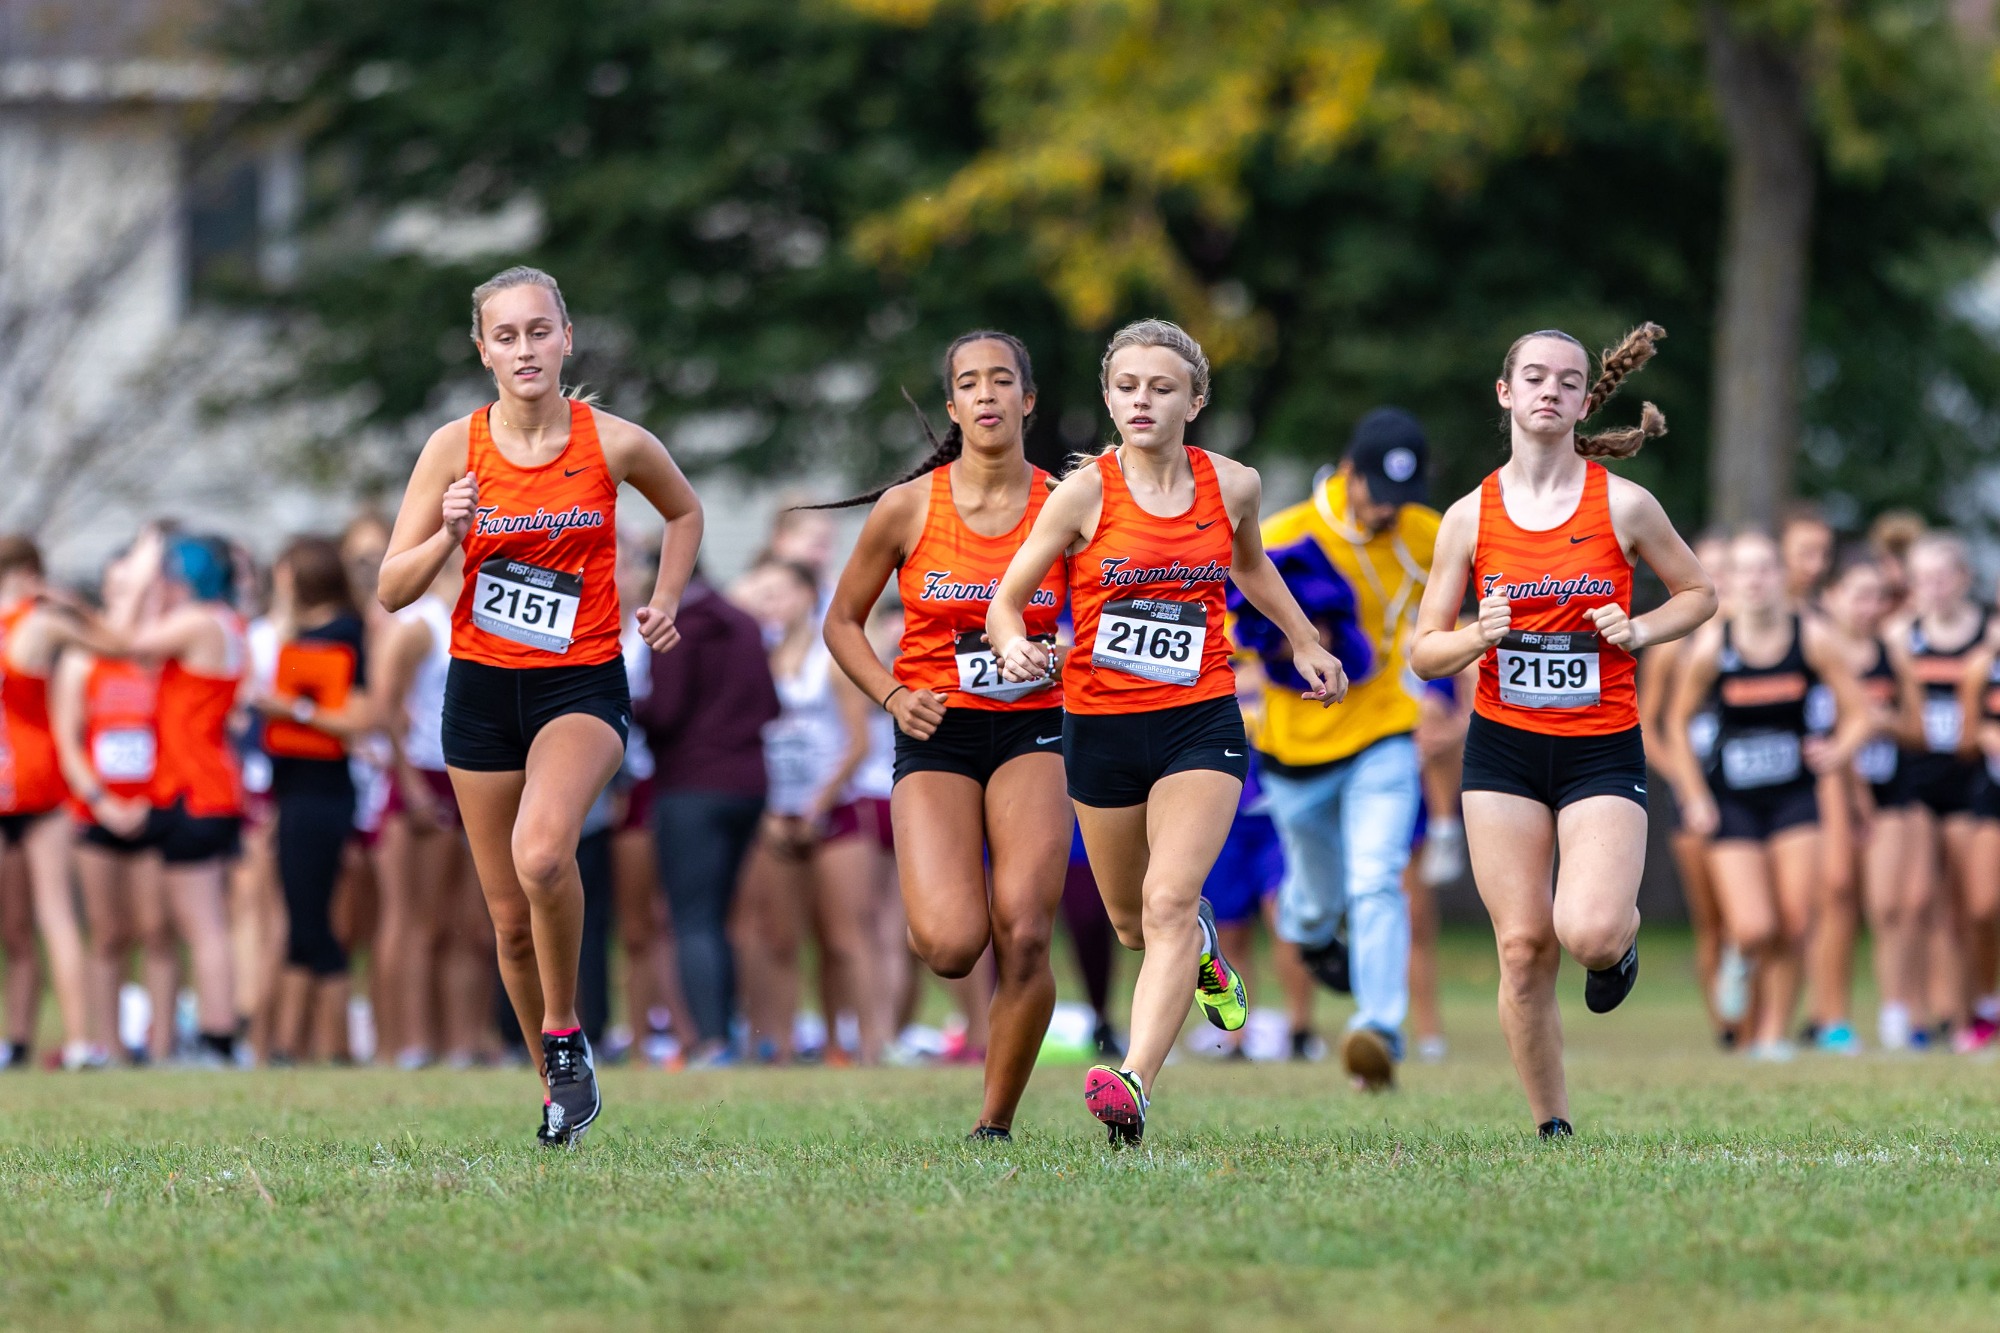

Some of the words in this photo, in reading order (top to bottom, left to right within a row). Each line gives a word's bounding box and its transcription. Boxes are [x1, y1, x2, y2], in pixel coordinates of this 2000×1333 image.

[476, 505, 604, 540] Farmington
[506, 561, 530, 575] FAST
[921, 571, 1056, 606] Farmion
[1131, 599, 1154, 611] FAST
[1483, 573, 1614, 606] Frmington
[484, 583, 561, 629] 2151
[1107, 622, 1192, 662] 2163
[1521, 633, 1543, 644] FAST
[1508, 656, 1588, 689] 2159
